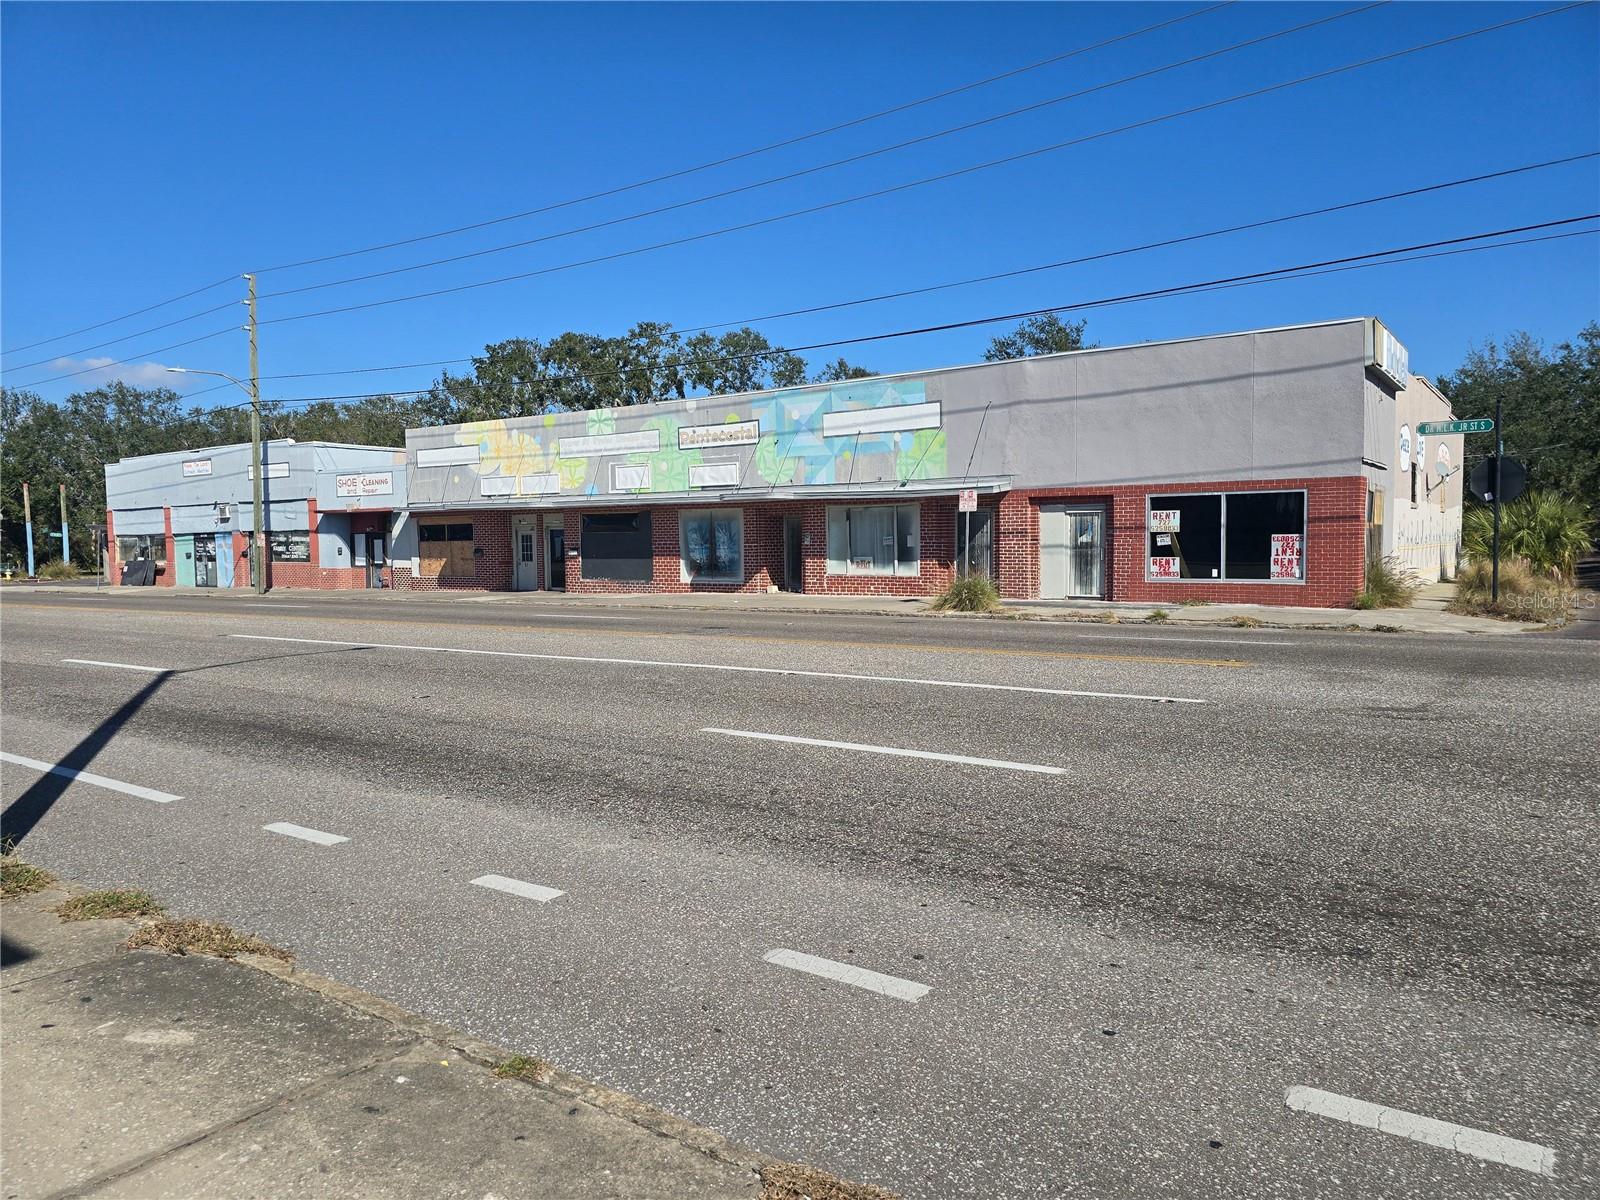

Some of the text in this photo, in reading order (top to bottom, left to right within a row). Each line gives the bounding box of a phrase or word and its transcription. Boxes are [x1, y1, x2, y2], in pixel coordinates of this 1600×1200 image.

[1459, 422, 1468, 431] JR
[1470, 422, 1478, 430] ST
[1480, 421, 1486, 429] S
[337, 478, 389, 488] SHOE CLEANING
[1152, 512, 1177, 520] RENT
[1274, 547, 1302, 557] RENT
[1152, 558, 1177, 566] RENT
[1273, 557, 1300, 566] RENT
